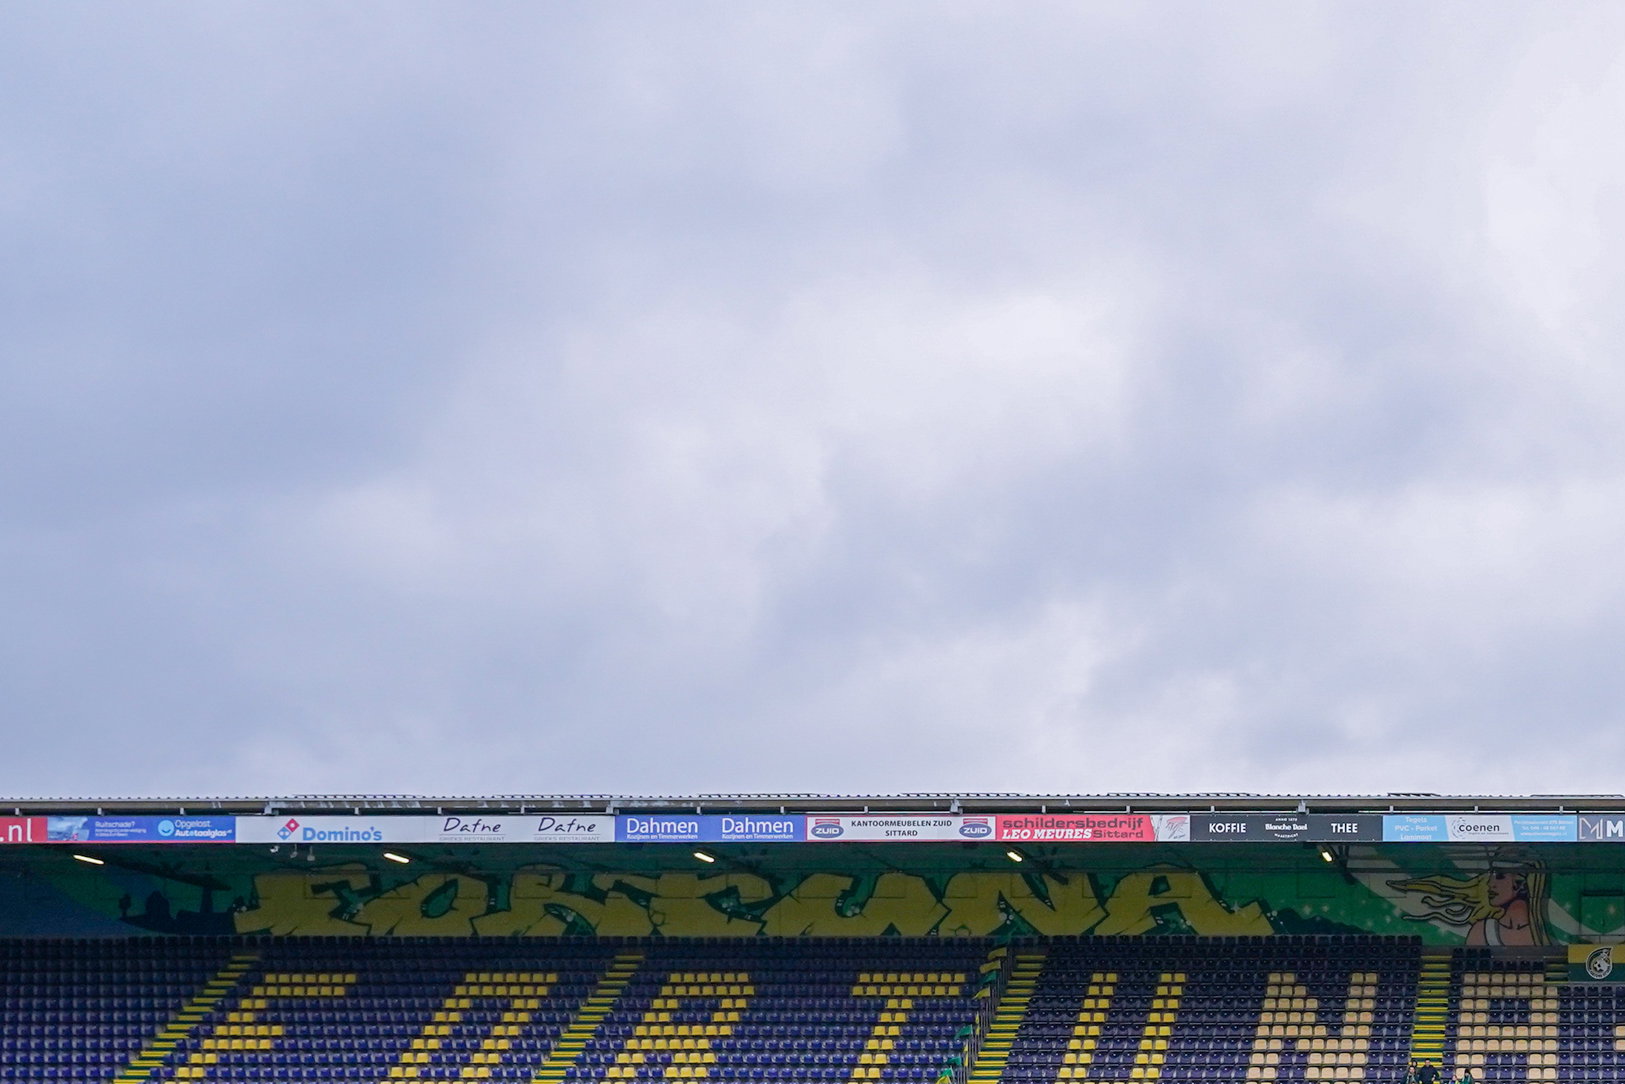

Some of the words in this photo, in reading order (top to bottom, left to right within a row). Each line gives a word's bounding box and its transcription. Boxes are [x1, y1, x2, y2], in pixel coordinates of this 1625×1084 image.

[443, 817, 501, 833] Dafne
[537, 817, 596, 833] Dafne
[626, 817, 698, 833] Dahmen
[721, 817, 794, 833] Dahmen
[1003, 817, 1143, 830] schildersbedrijf
[1209, 823, 1246, 833] KOFFIE
[1331, 823, 1358, 833] THEE
[1458, 823, 1500, 833] coenen
[302, 826, 382, 841] Domino's
[814, 827, 839, 835] ZUID
[963, 826, 987, 834] ZUID
[1002, 829, 1031, 839] LEO
[1033, 829, 1092, 839] MEURES
[1093, 830, 1143, 839] Sittard
